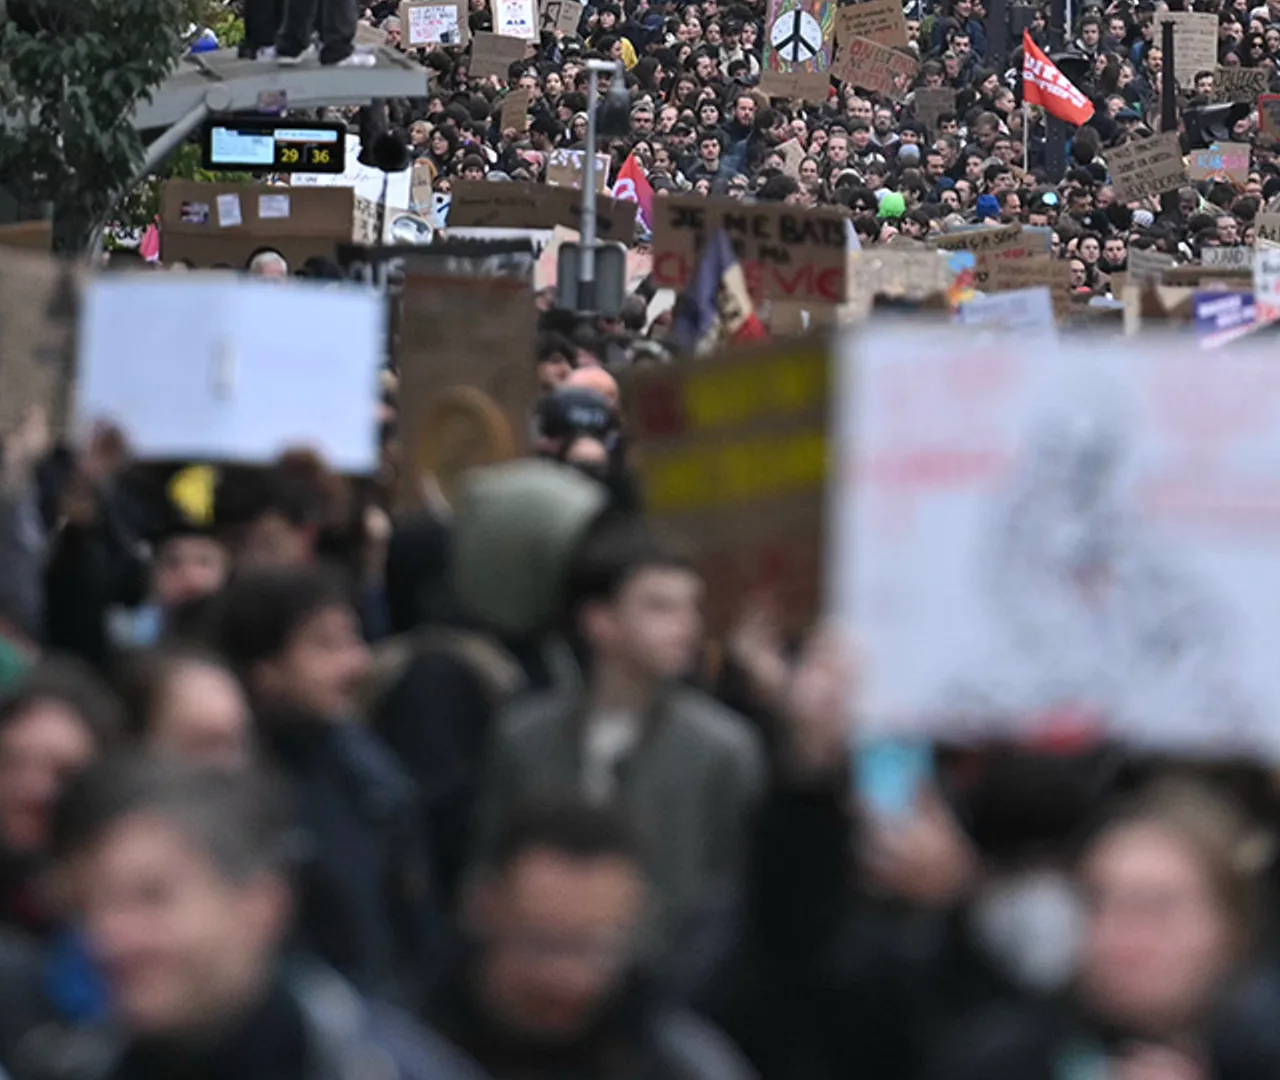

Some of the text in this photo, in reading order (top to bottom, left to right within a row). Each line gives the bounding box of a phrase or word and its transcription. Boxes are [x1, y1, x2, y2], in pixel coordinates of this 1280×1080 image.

[281, 148, 330, 164] 29 36
[670, 205, 706, 230] JE
[777, 213, 848, 246] BATS
